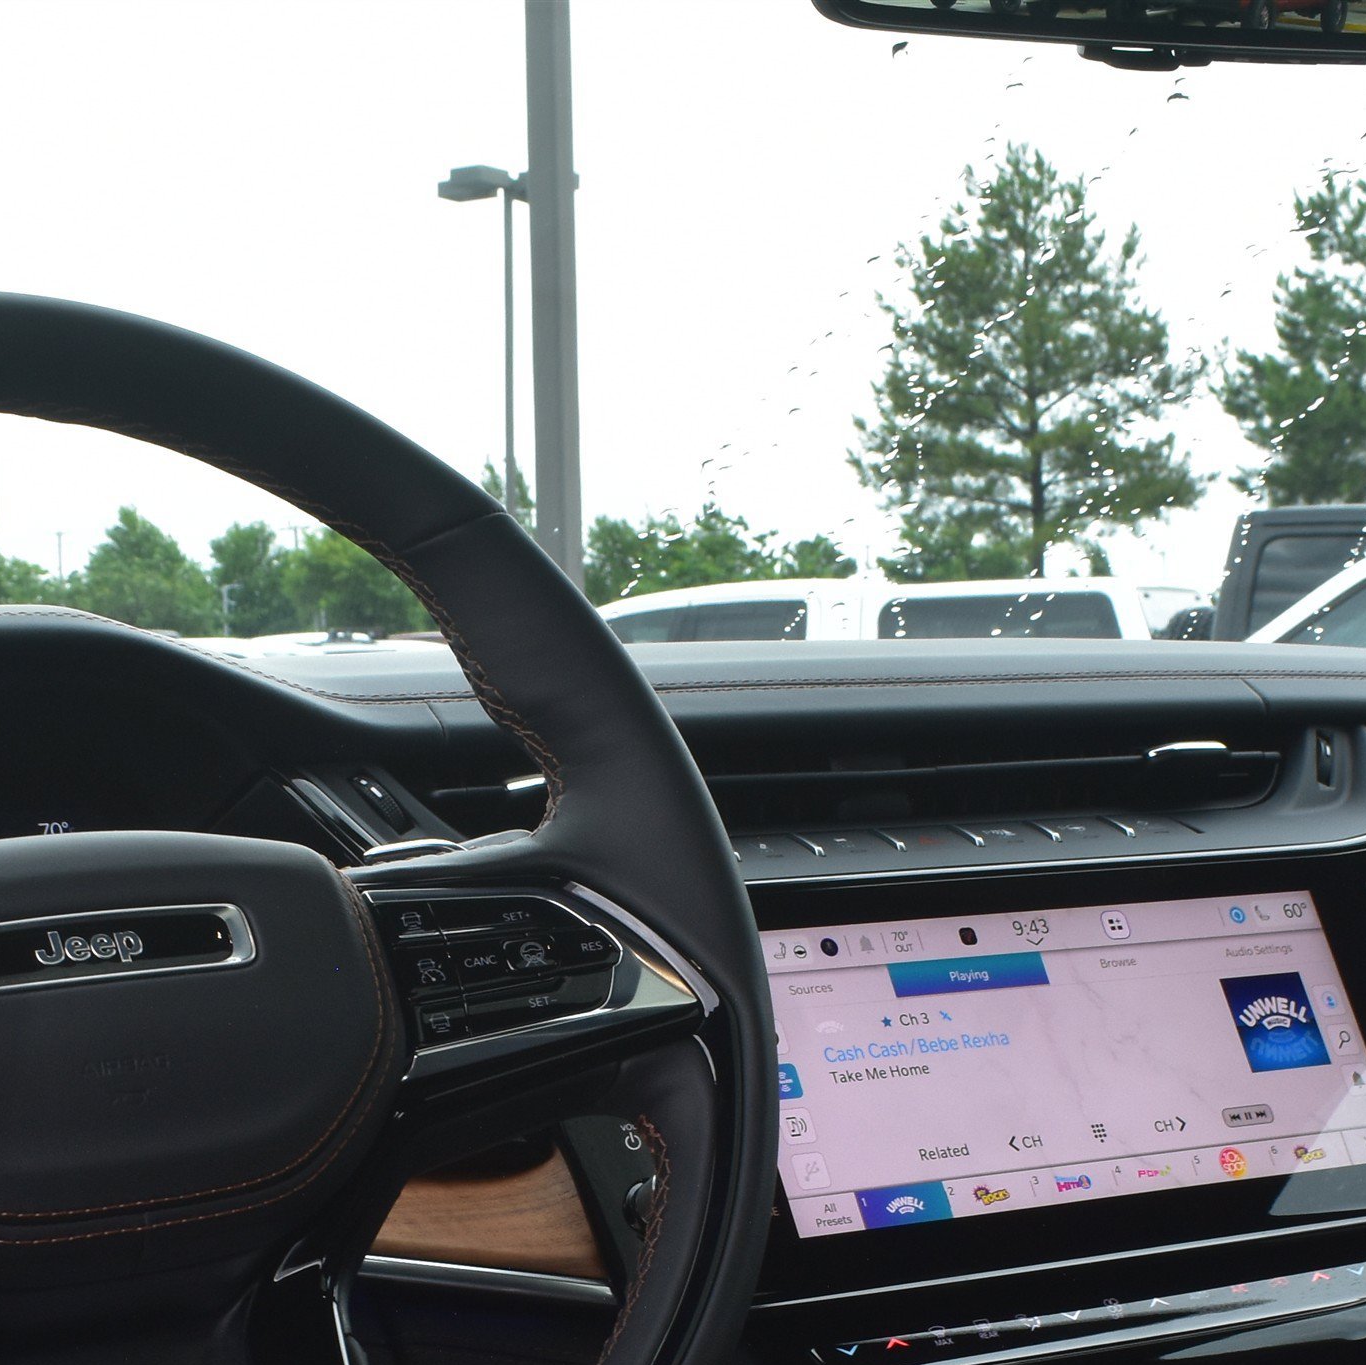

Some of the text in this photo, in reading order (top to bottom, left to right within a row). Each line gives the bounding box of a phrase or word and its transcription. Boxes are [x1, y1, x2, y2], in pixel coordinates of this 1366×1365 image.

[1282, 901, 1308, 919] 60°
[1012, 917, 1050, 937] 9:43
[891, 930, 909, 942] 70°
[35, 930, 144, 966] Jeep
[580, 940, 604, 952] RES
[895, 942, 914, 954] OUT
[1225, 942, 1294, 959] Audio Settings
[463, 954, 498, 969] CANC
[1099, 956, 1138, 969] Browse
[949, 968, 990, 983] Playing
[788, 982, 834, 996] Sources
[1238, 996, 1309, 1028] UNWELL
[898, 1012, 930, 1027] Ch 3
[823, 1043, 866, 1063] Cash
[961, 1031, 1010, 1049] Rexha
[829, 1063, 931, 1085] Take Me Home
[1153, 1119, 1175, 1133] CH
[1021, 1134, 1044, 1150] CH
[918, 1143, 971, 1162] Related
[1270, 1145, 1278, 1155] 6
[1193, 1155, 1201, 1165] 5
[1114, 1165, 1122, 1175] 4
[1031, 1176, 1040, 1186] 3
[947, 1186, 955, 1196] 2
[823, 1202, 838, 1214] All
[861, 1197, 867, 1207] 1
[885, 1195, 926, 1215] UNWELL
[815, 1214, 853, 1229] Presets
[933, 1337, 955, 1347] MAX
